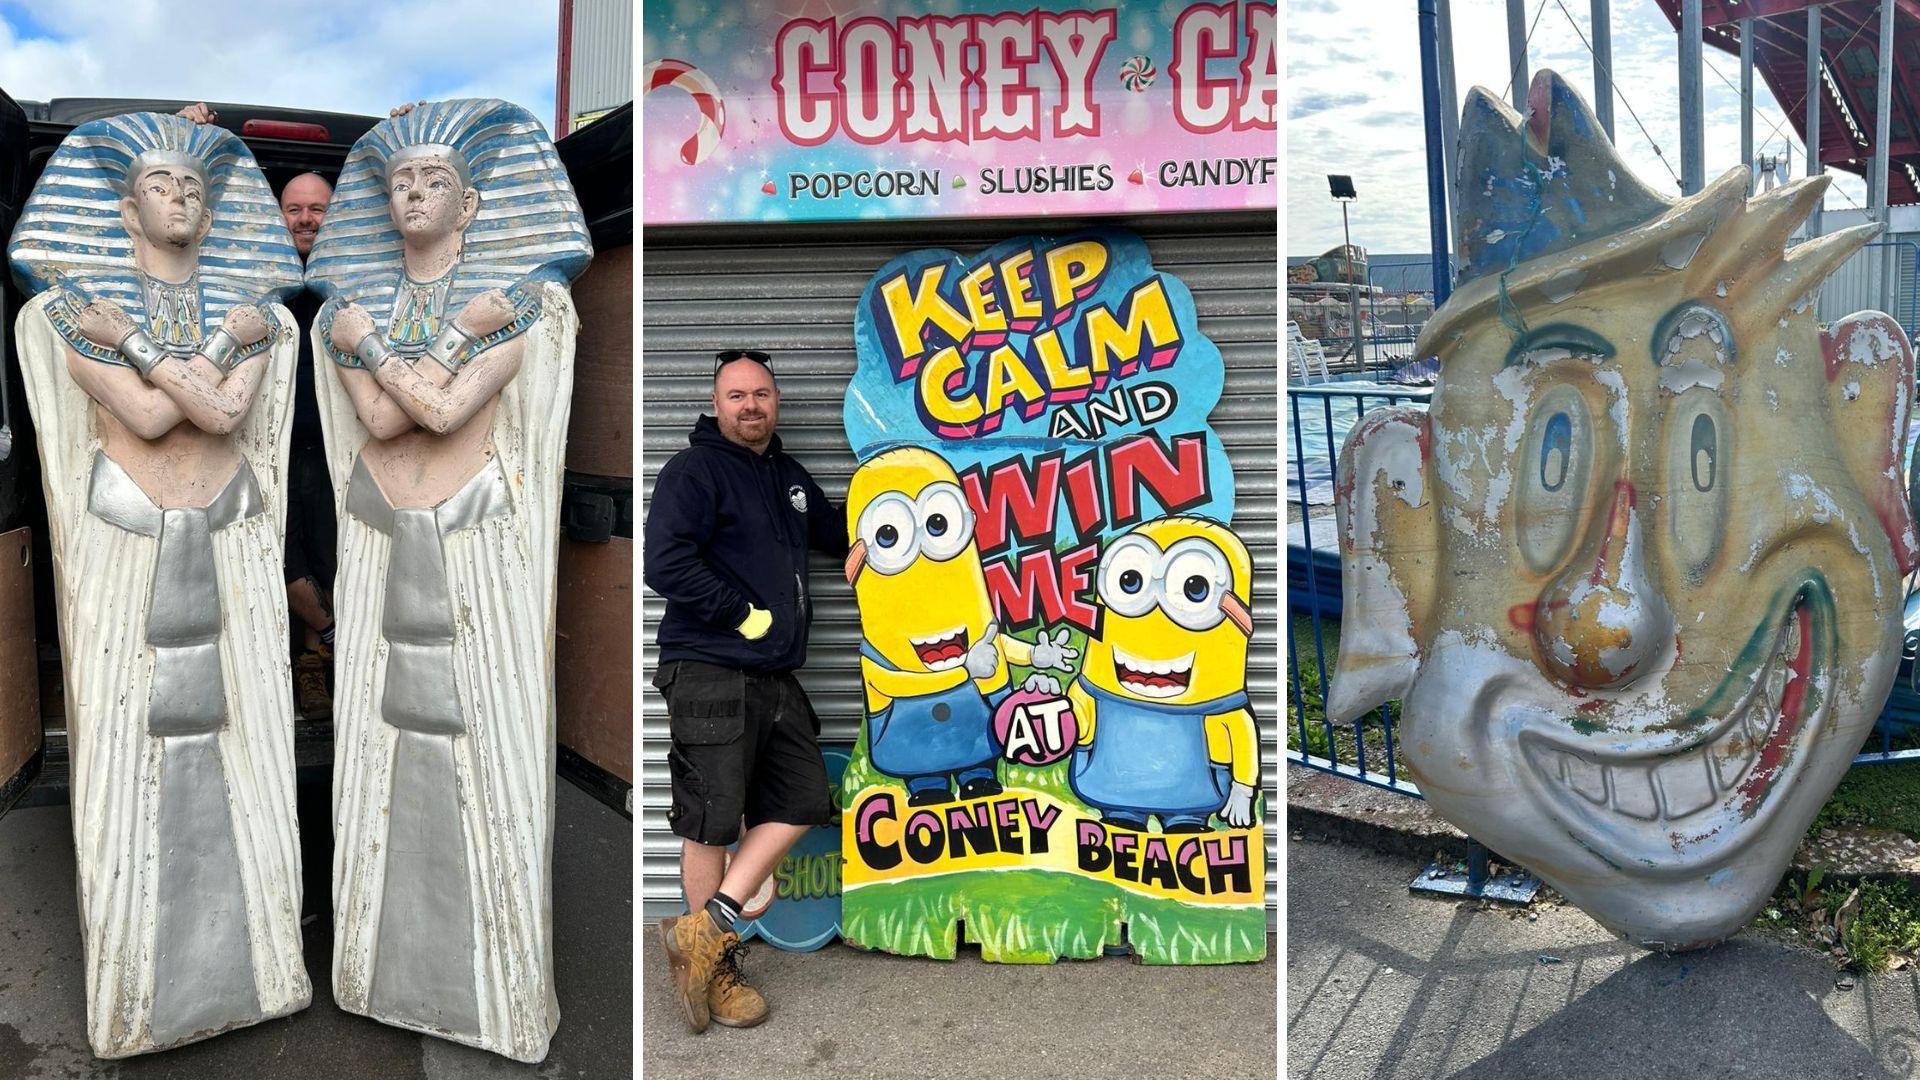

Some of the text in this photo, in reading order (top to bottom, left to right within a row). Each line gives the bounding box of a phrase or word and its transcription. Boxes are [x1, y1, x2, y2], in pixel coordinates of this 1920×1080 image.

[771, 8, 1117, 147] CONEY
[788, 156, 1277, 200] POPCORN SLUSHIES CANDYF
[880, 240, 1109, 371] KEEP
[917, 278, 1181, 432] CALM
[1050, 383, 1176, 440] AND
[962, 432, 1208, 552] WIN
[984, 543, 1102, 634] ME
[1004, 697, 1073, 763] AT
[855, 793, 1062, 871] CONEY
[1075, 818, 1252, 896] BEACH
